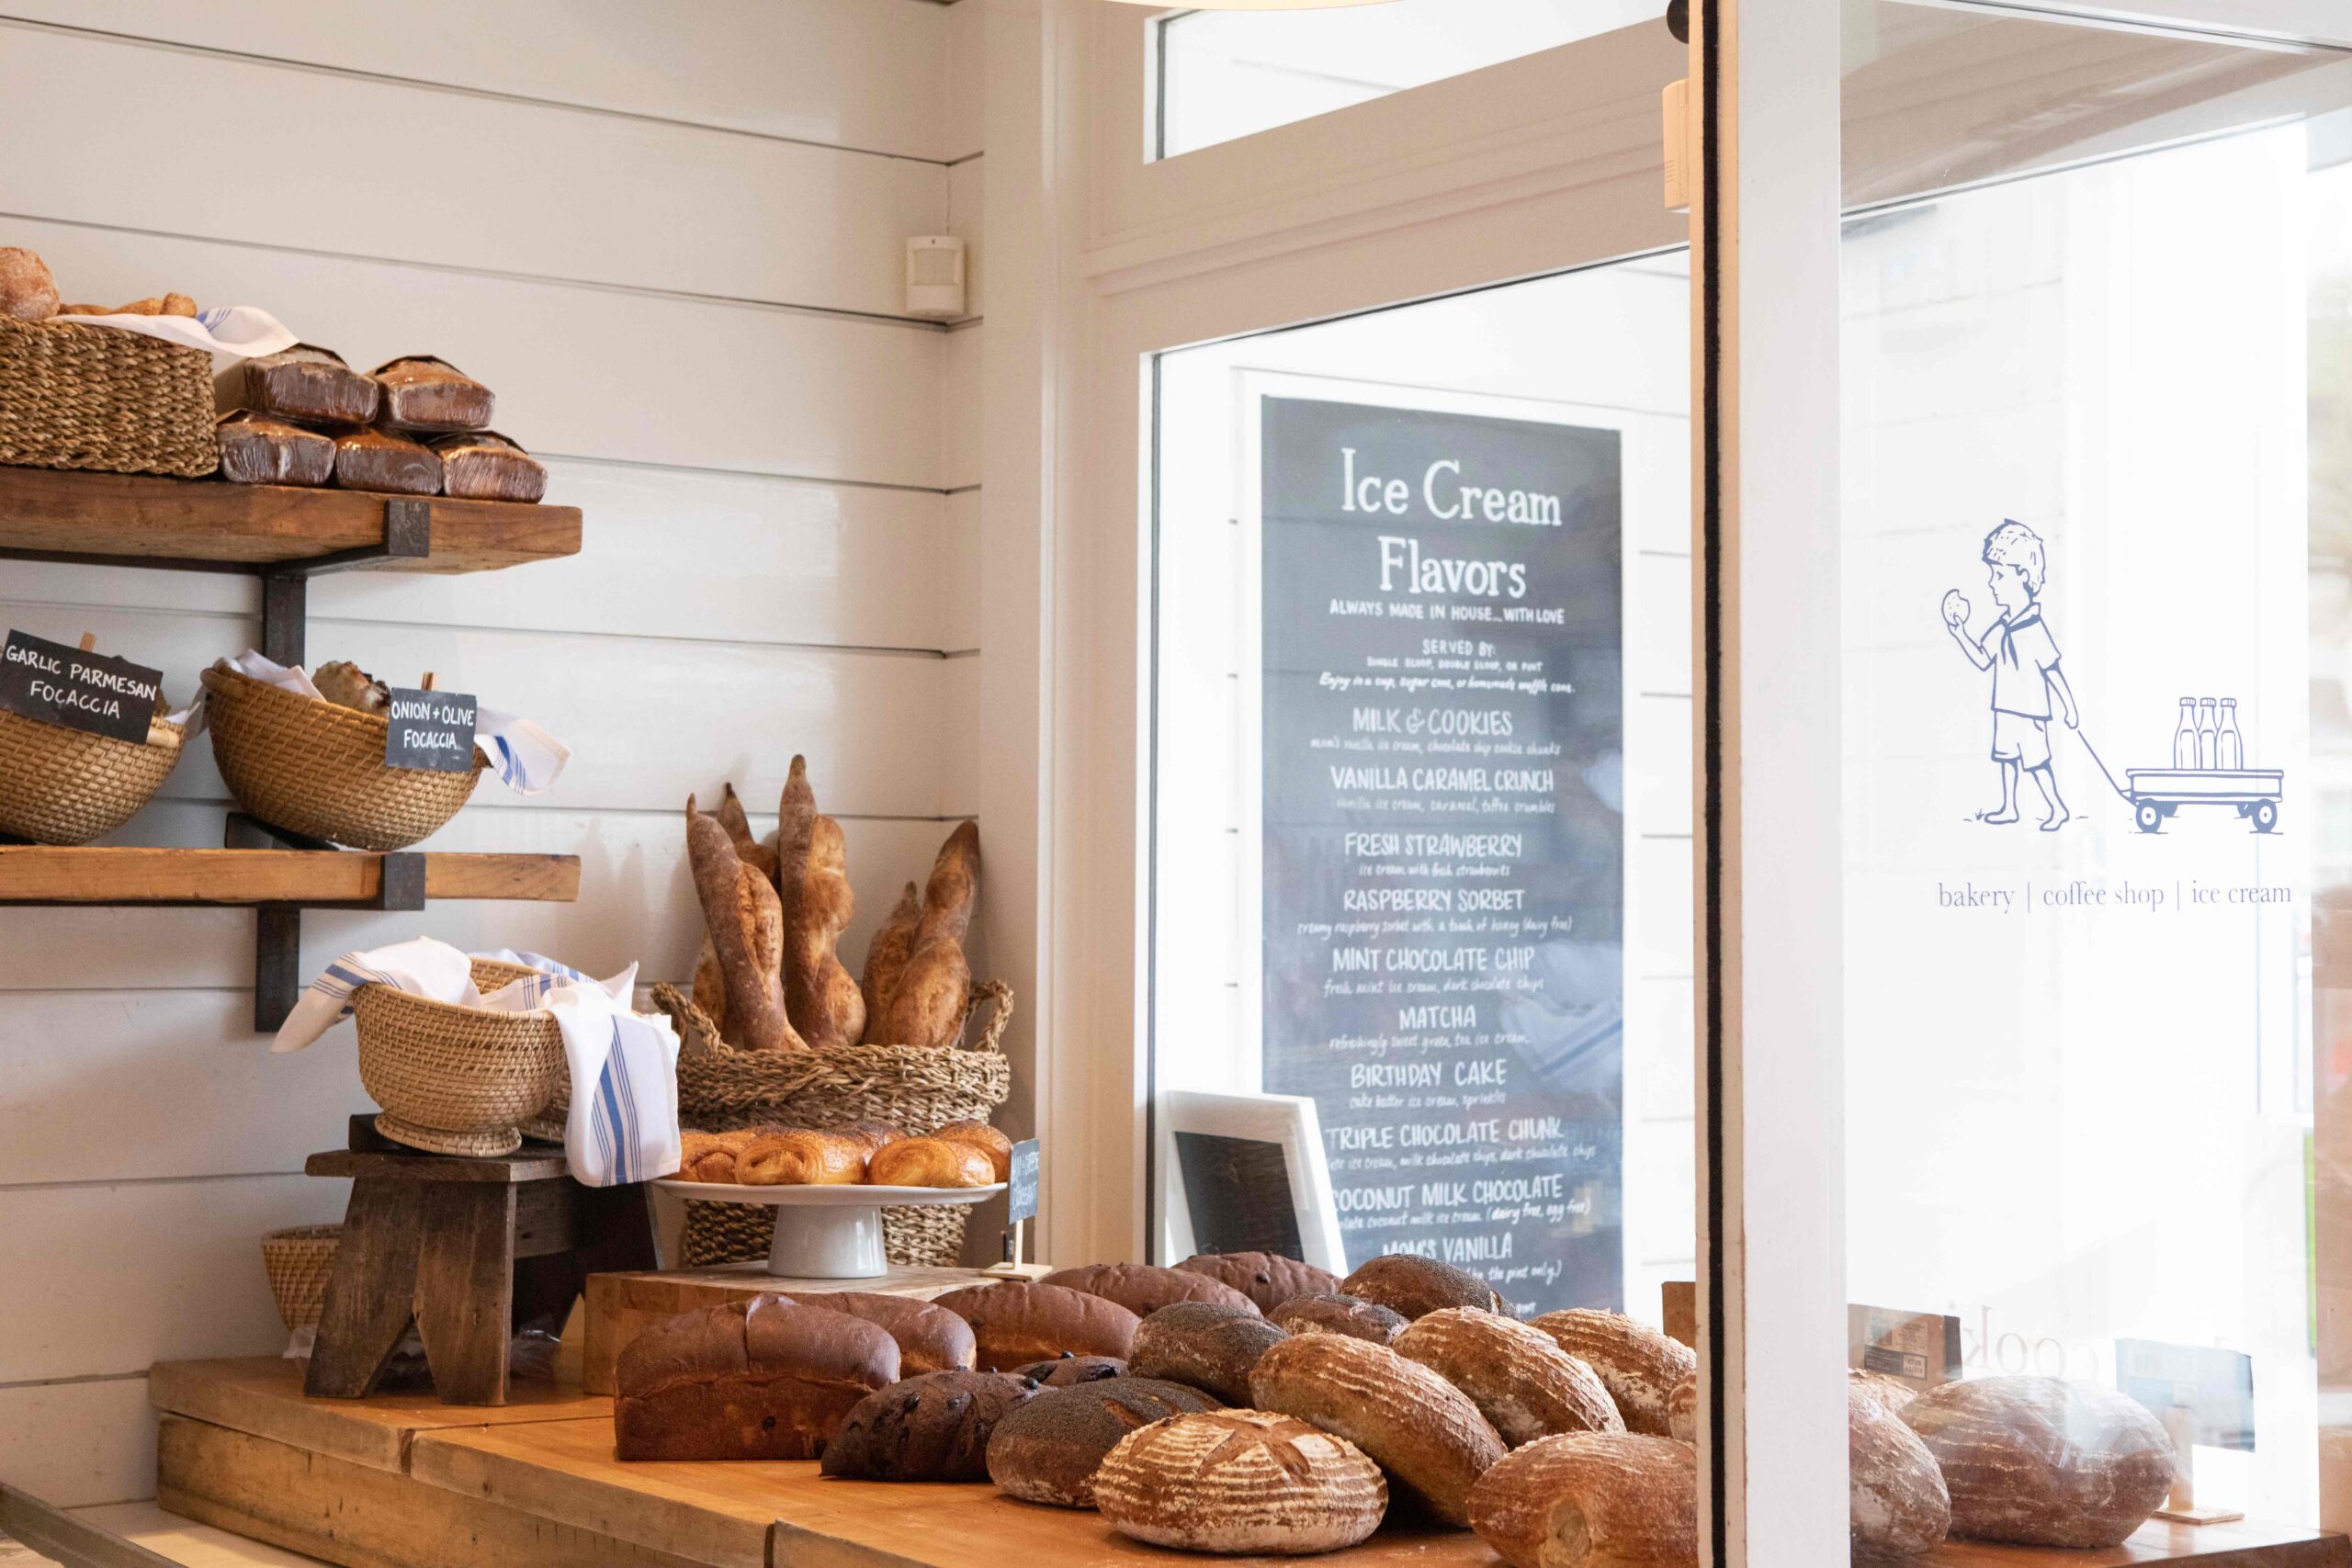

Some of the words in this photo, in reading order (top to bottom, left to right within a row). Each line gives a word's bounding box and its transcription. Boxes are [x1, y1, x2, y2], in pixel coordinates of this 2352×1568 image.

[1340, 446, 1409, 514] Ice
[1422, 459, 1563, 526] Cream
[1377, 536, 1527, 599] Flavors
[1329, 598, 1384, 616] ALWAYS
[1389, 602, 1425, 619] MADE
[1430, 604, 1445, 619] IN
[1535, 607, 1565, 625] LOVE
[1422, 638, 1474, 656] SERVED
[6, 645, 62, 675] GARLIC
[70, 663, 157, 701] PARMESAN
[1318, 671, 1351, 692] Enjoy
[29, 680, 121, 719] FOCACCIA
[390, 700, 431, 721] ONION
[442, 705, 475, 727] OLIVE
[1352, 706, 1403, 733] MILK
[1406, 707, 1426, 734] &
[1428, 708, 1514, 736] COOKIES
[404, 728, 457, 750] FOCACCIA
[1329, 765, 1408, 791] VANILLA
[1412, 768, 1493, 792] CARAMEL
[1494, 768, 1555, 793] CRUNCH
[1344, 831, 1400, 857] FRESH
[1405, 833, 1522, 859] STRAWBERRY
[1343, 889, 1452, 911] RASPBERRY
[1457, 889, 1526, 912] SORBET
[1938, 882, 2016, 914] bakery
[2043, 880, 2108, 906] coffee
[2114, 880, 2165, 912] shop
[2192, 879, 2222, 904] ice
[2228, 886, 2292, 904] cream
[1332, 947, 1382, 972] MINT
[1385, 947, 1487, 972] CHOCOLATE
[1495, 946, 1535, 972] CHIP
[1399, 1004, 1477, 1031] MATCHA
[1351, 1062, 1442, 1089] BIRTHDAY
[1454, 1058, 1508, 1086] CAKE
[1325, 1126, 1395, 1150] TRIPLE
[1399, 1118, 1500, 1147] CHOCOLATE
[1508, 1116, 1565, 1141] CHUNK
[1421, 1182, 1468, 1207] MILK
[1472, 1173, 1564, 1205] CHOCOLATE
[1442, 1232, 1512, 1262] VANILLA
